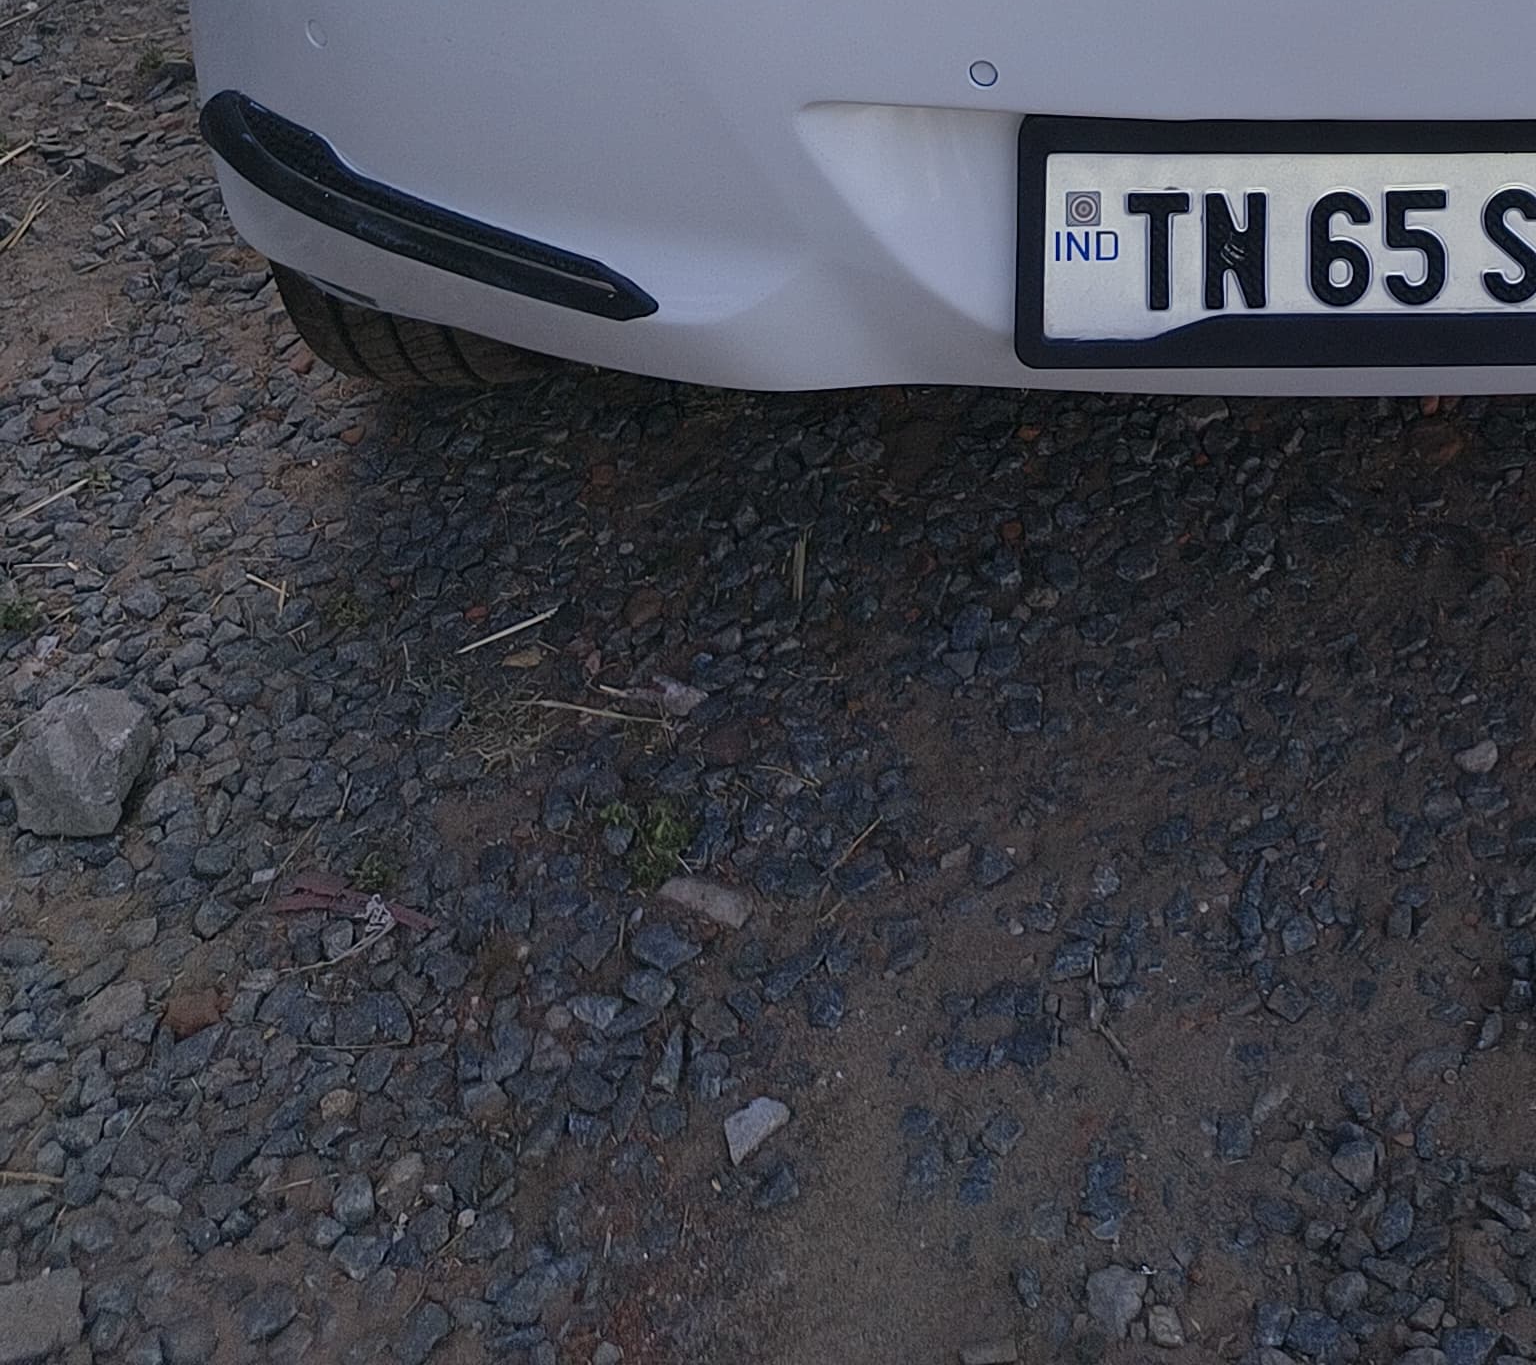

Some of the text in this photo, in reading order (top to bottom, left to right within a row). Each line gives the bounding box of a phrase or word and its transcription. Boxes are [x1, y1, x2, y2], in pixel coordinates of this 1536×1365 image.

[1055, 230, 1119, 262] IND
[1124, 189, 1267, 312] TN
[1306, 186, 1449, 309] 65
